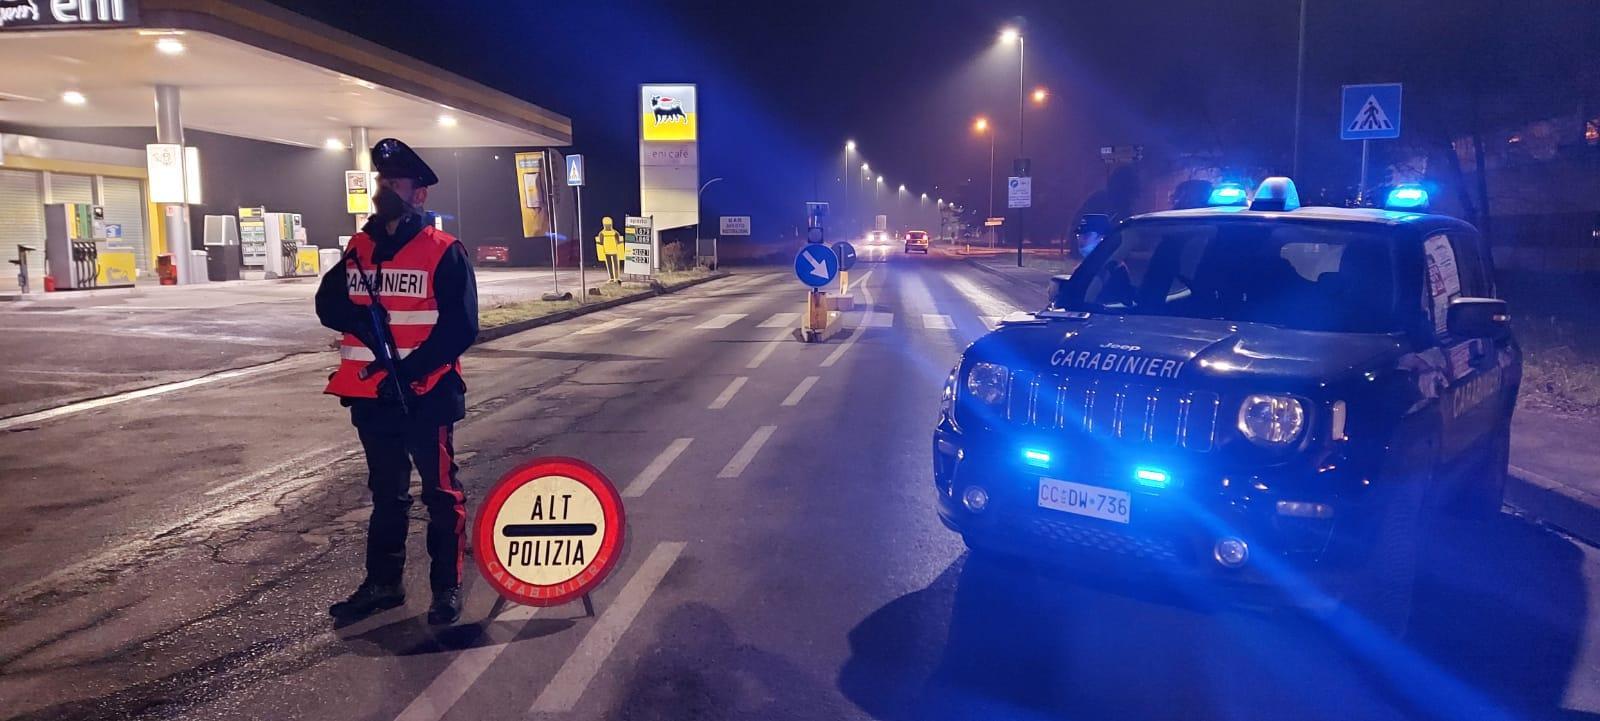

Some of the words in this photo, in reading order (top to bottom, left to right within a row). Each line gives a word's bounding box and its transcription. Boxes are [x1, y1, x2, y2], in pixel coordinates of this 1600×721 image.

[50, 0, 125, 22] eni
[346, 271, 424, 295] ARAINIERI
[1099, 342, 1142, 352] Jeep
[1051, 349, 1185, 379] CARABINIERI
[530, 494, 573, 521] ALT
[1097, 494, 1128, 516] 736
[507, 540, 585, 567] POLIZIA
[487, 558, 608, 598] CARABINIERI
